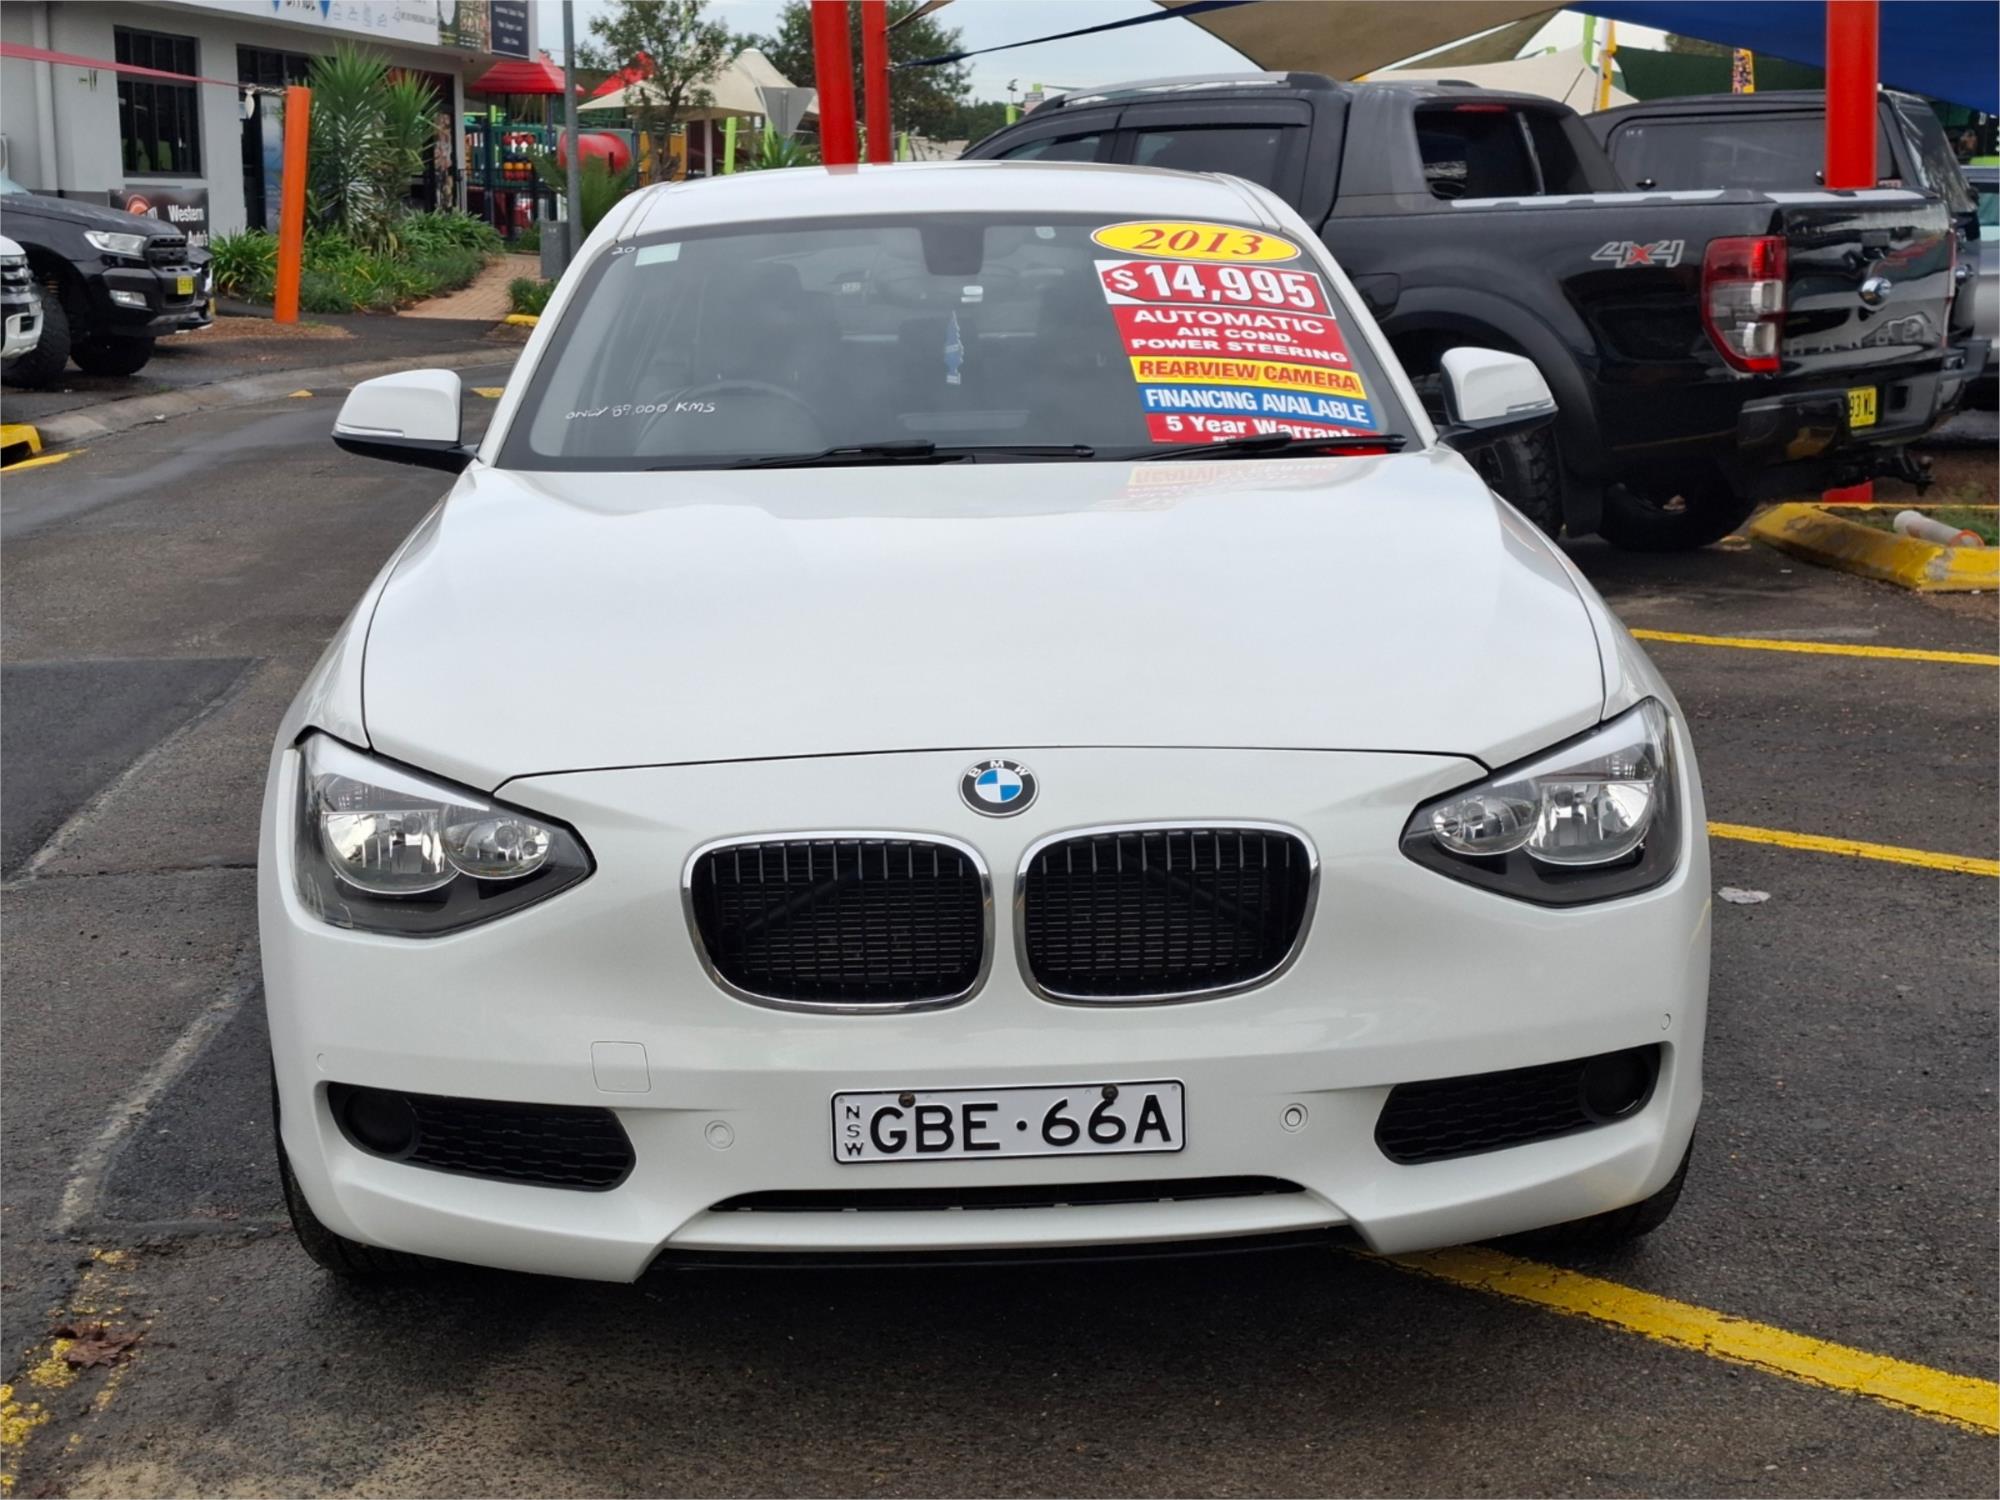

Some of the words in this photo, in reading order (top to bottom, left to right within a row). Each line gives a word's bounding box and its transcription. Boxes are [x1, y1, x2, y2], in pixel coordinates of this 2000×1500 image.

[168, 204, 204, 222] Western
[1133, 229, 1264, 256] 2013
[1134, 309, 1326, 335] AUTOMATIC
[1177, 326, 1219, 339] AIR
[1224, 328, 1299, 345] COND.
[1131, 338, 1218, 351] POWER
[1227, 341, 1348, 362] STEERING
[1139, 360, 1260, 380] REARVIEW
[1263, 364, 1359, 391] CAMERA
[674, 402, 716, 413] KMS
[1145, 388, 1258, 411] FINANCING
[1262, 393, 1371, 424] AVAILABLE
[1166, 415, 1184, 432] 5
[1188, 415, 1248, 433] Year
[1252, 418, 1362, 440] Warrant
[967, 759, 1032, 778] BMW
